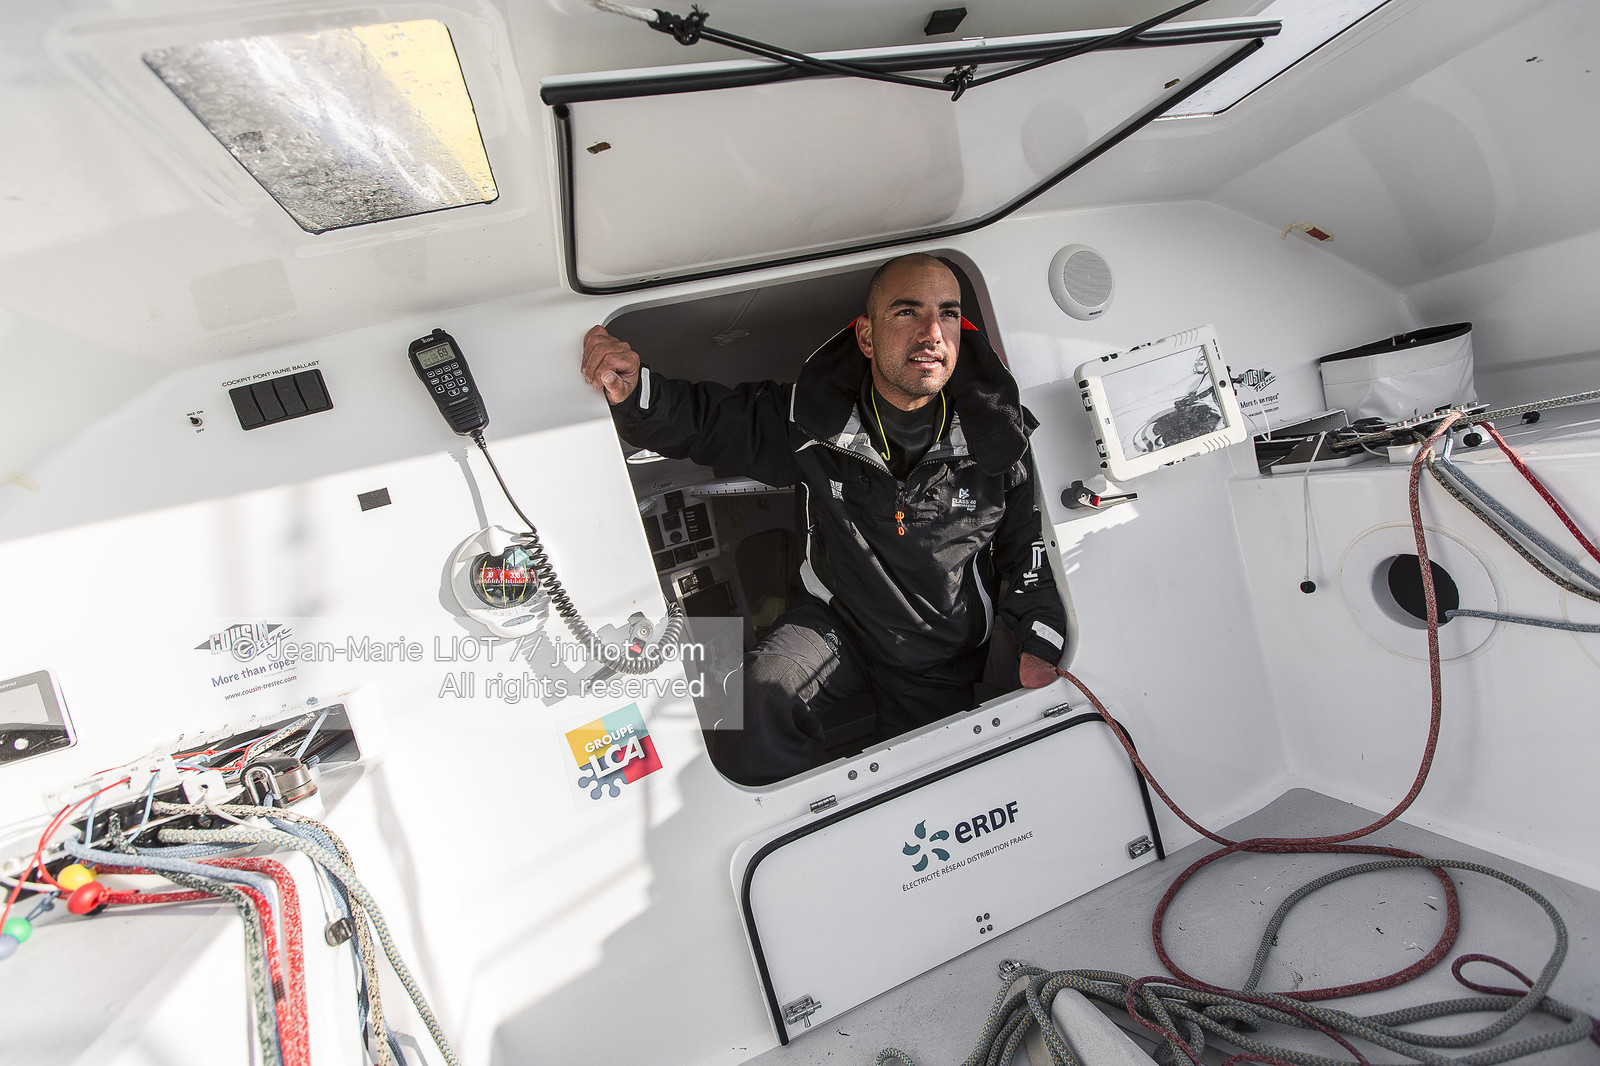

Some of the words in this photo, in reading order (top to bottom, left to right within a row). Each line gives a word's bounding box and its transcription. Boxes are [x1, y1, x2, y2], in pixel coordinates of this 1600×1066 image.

[437, 347, 449, 358] 69
[221, 376, 251, 387] COCKPIT
[252, 371, 271, 380] PONT
[272, 366, 292, 375] HUNE
[292, 360, 320, 371] BALLAST
[211, 673, 240, 688] More
[241, 664, 267, 680] than
[224, 675, 298, 701] www.cousin-trestec.com
[584, 723, 635, 754] GROUPE
[588, 735, 646, 779] LCA
[954, 800, 1019, 844] eRDF
[901, 869, 941, 892] ÉLECTRICITÉ
[941, 859, 966, 875] RÉSEAU
[967, 841, 1010, 865] DISTRIBUTION
[1009, 830, 1034, 846] FRANCE
